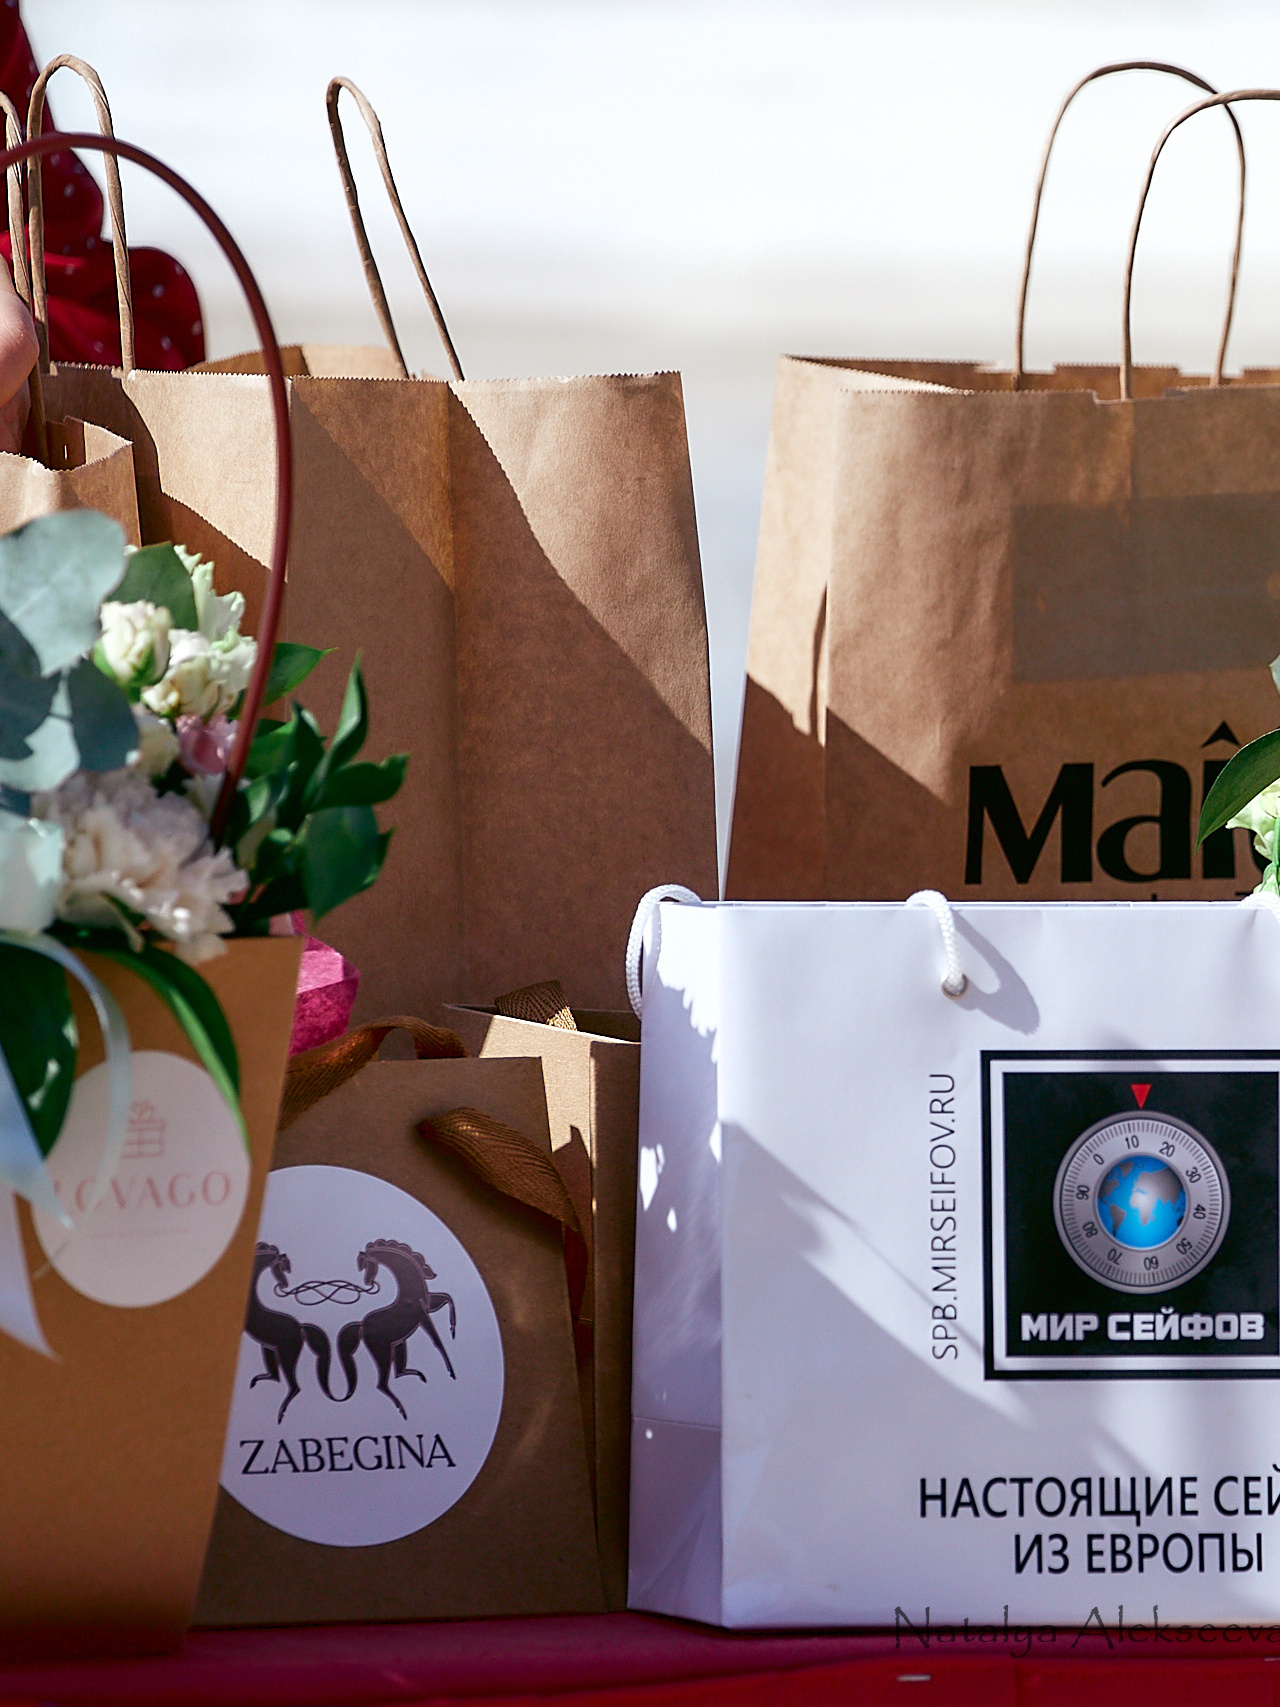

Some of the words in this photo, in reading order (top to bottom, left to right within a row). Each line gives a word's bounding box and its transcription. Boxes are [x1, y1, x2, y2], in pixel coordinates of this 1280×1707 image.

[1125, 1135, 1140, 1150] 10
[1158, 1141, 1176, 1158] 20
[1093, 1153, 1105, 1166] 0
[1185, 1167, 1202, 1184] 30
[1075, 1185, 1090, 1201] 90
[929, 1073, 959, 1360] SPB.MIRSEIFOV.RU
[1193, 1204, 1206, 1220] 40
[1082, 1221, 1098, 1239] 80
[1175, 1238, 1193, 1255] 50
[1107, 1248, 1123, 1266] 70
[1143, 1256, 1159, 1271] 60
[1020, 1312, 1099, 1342] МИР
[1107, 1306, 1266, 1342] СЕЙФОВ
[239, 1433, 457, 1475] ZABEGINA
[919, 1476, 1199, 1526] НАСТОЯЩИЕ
[1014, 1534, 1070, 1574] ИЗ
[1086, 1532, 1264, 1574] ЕВРОПЫ
